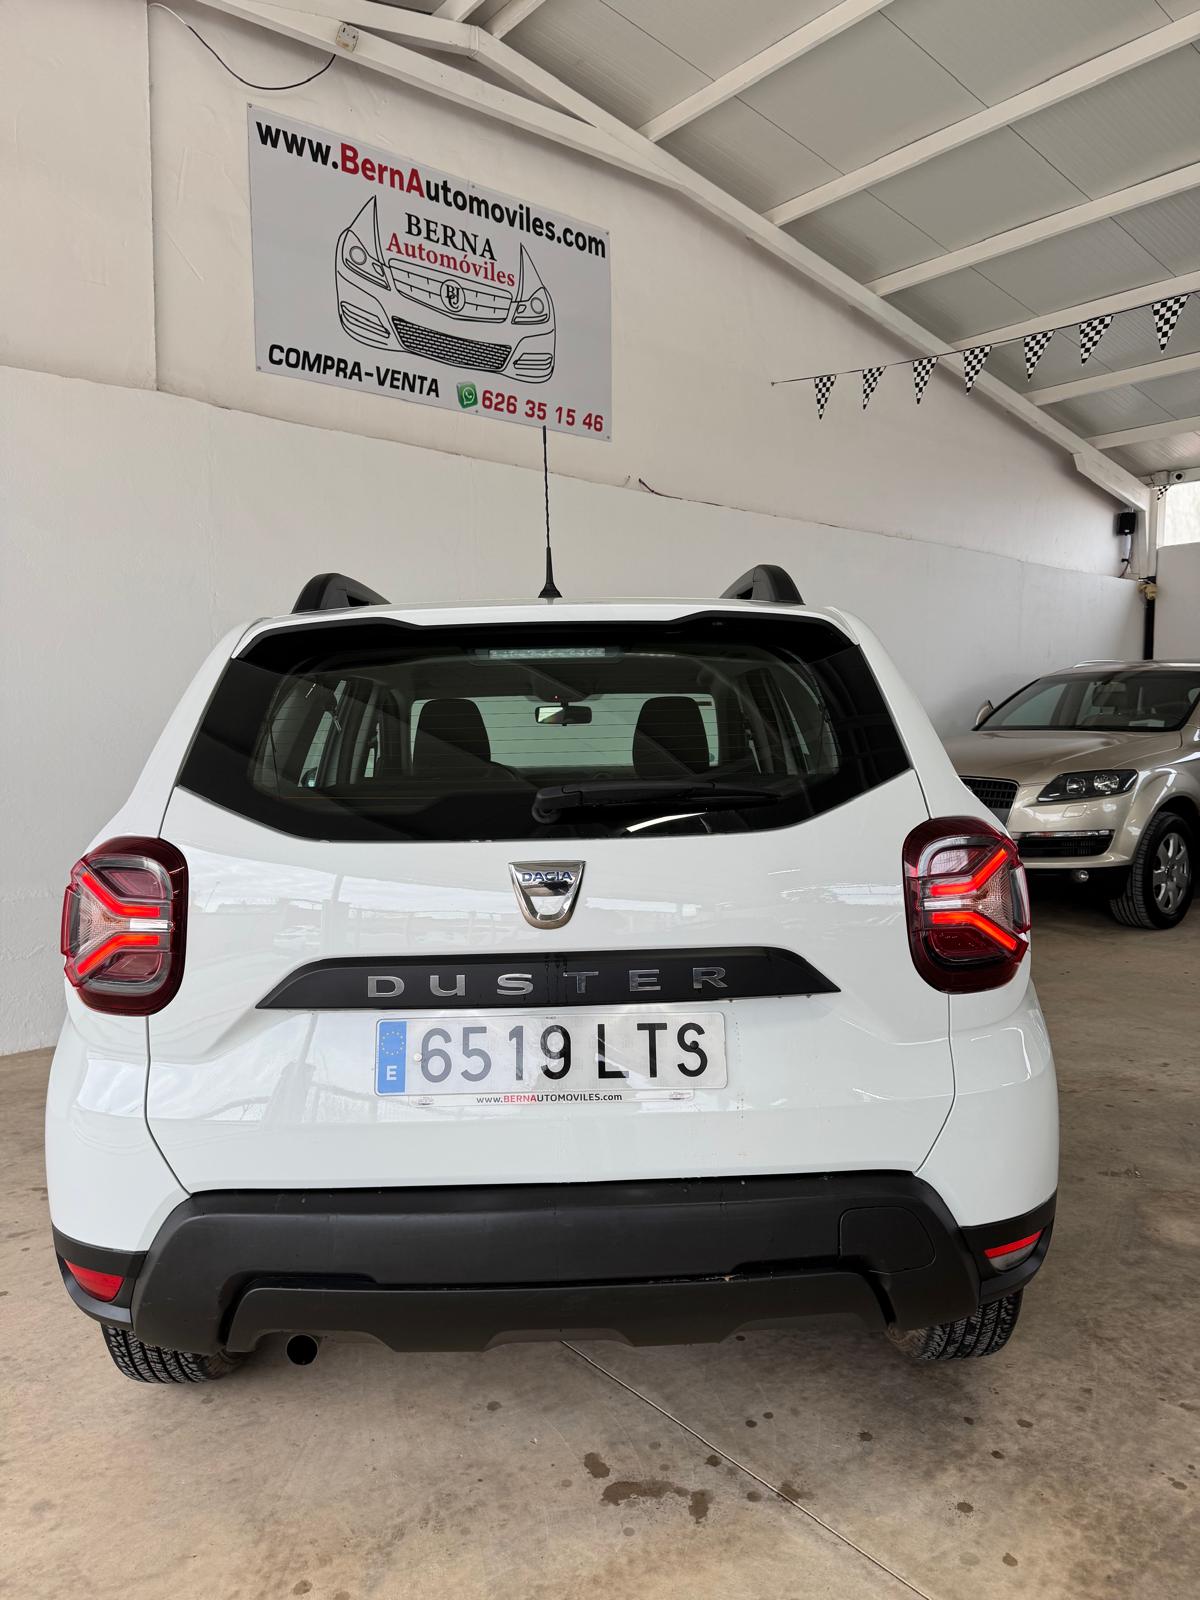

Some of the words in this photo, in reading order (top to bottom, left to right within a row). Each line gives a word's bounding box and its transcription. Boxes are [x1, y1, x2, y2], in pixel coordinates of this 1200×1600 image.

[256, 121, 606, 258] www.BernAutomoviles.com
[386, 232, 516, 287] Automóviles
[405, 212, 498, 261] BERNA
[268, 344, 440, 398] COMPRA-VENTA
[481, 389, 518, 414] 626
[525, 400, 547, 421] 35
[555, 406, 576, 427] 15
[583, 413, 604, 433] 46
[521, 871, 573, 882] DACIA
[367, 966, 729, 998] DUSTER
[386, 1065, 398, 1081] E
[421, 1025, 573, 1084] 6519
[598, 1022, 708, 1080] LTS
[476, 1093, 623, 1104] www.BERNAUTOMOVILES.com
